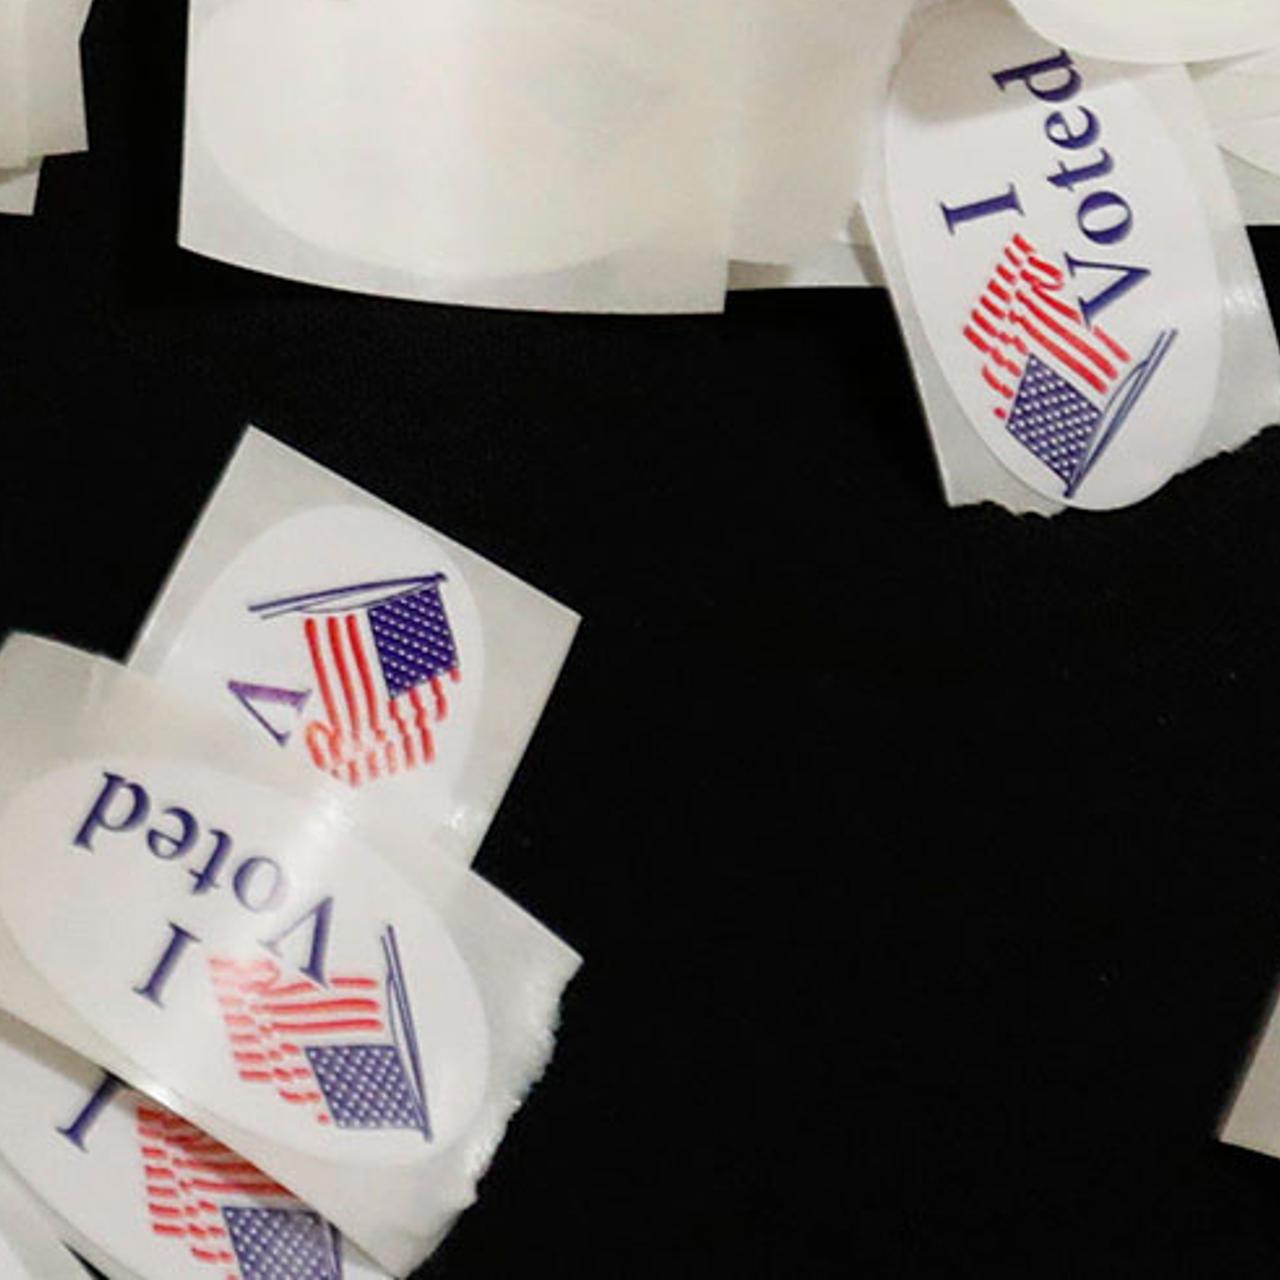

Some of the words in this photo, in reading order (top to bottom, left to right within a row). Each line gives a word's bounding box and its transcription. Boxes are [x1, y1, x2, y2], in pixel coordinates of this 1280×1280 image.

[938, 181, 1026, 236] I
[990, 47, 1153, 327] Voted
[72, 771, 336, 989] Voted
[132, 920, 203, 1010] I
